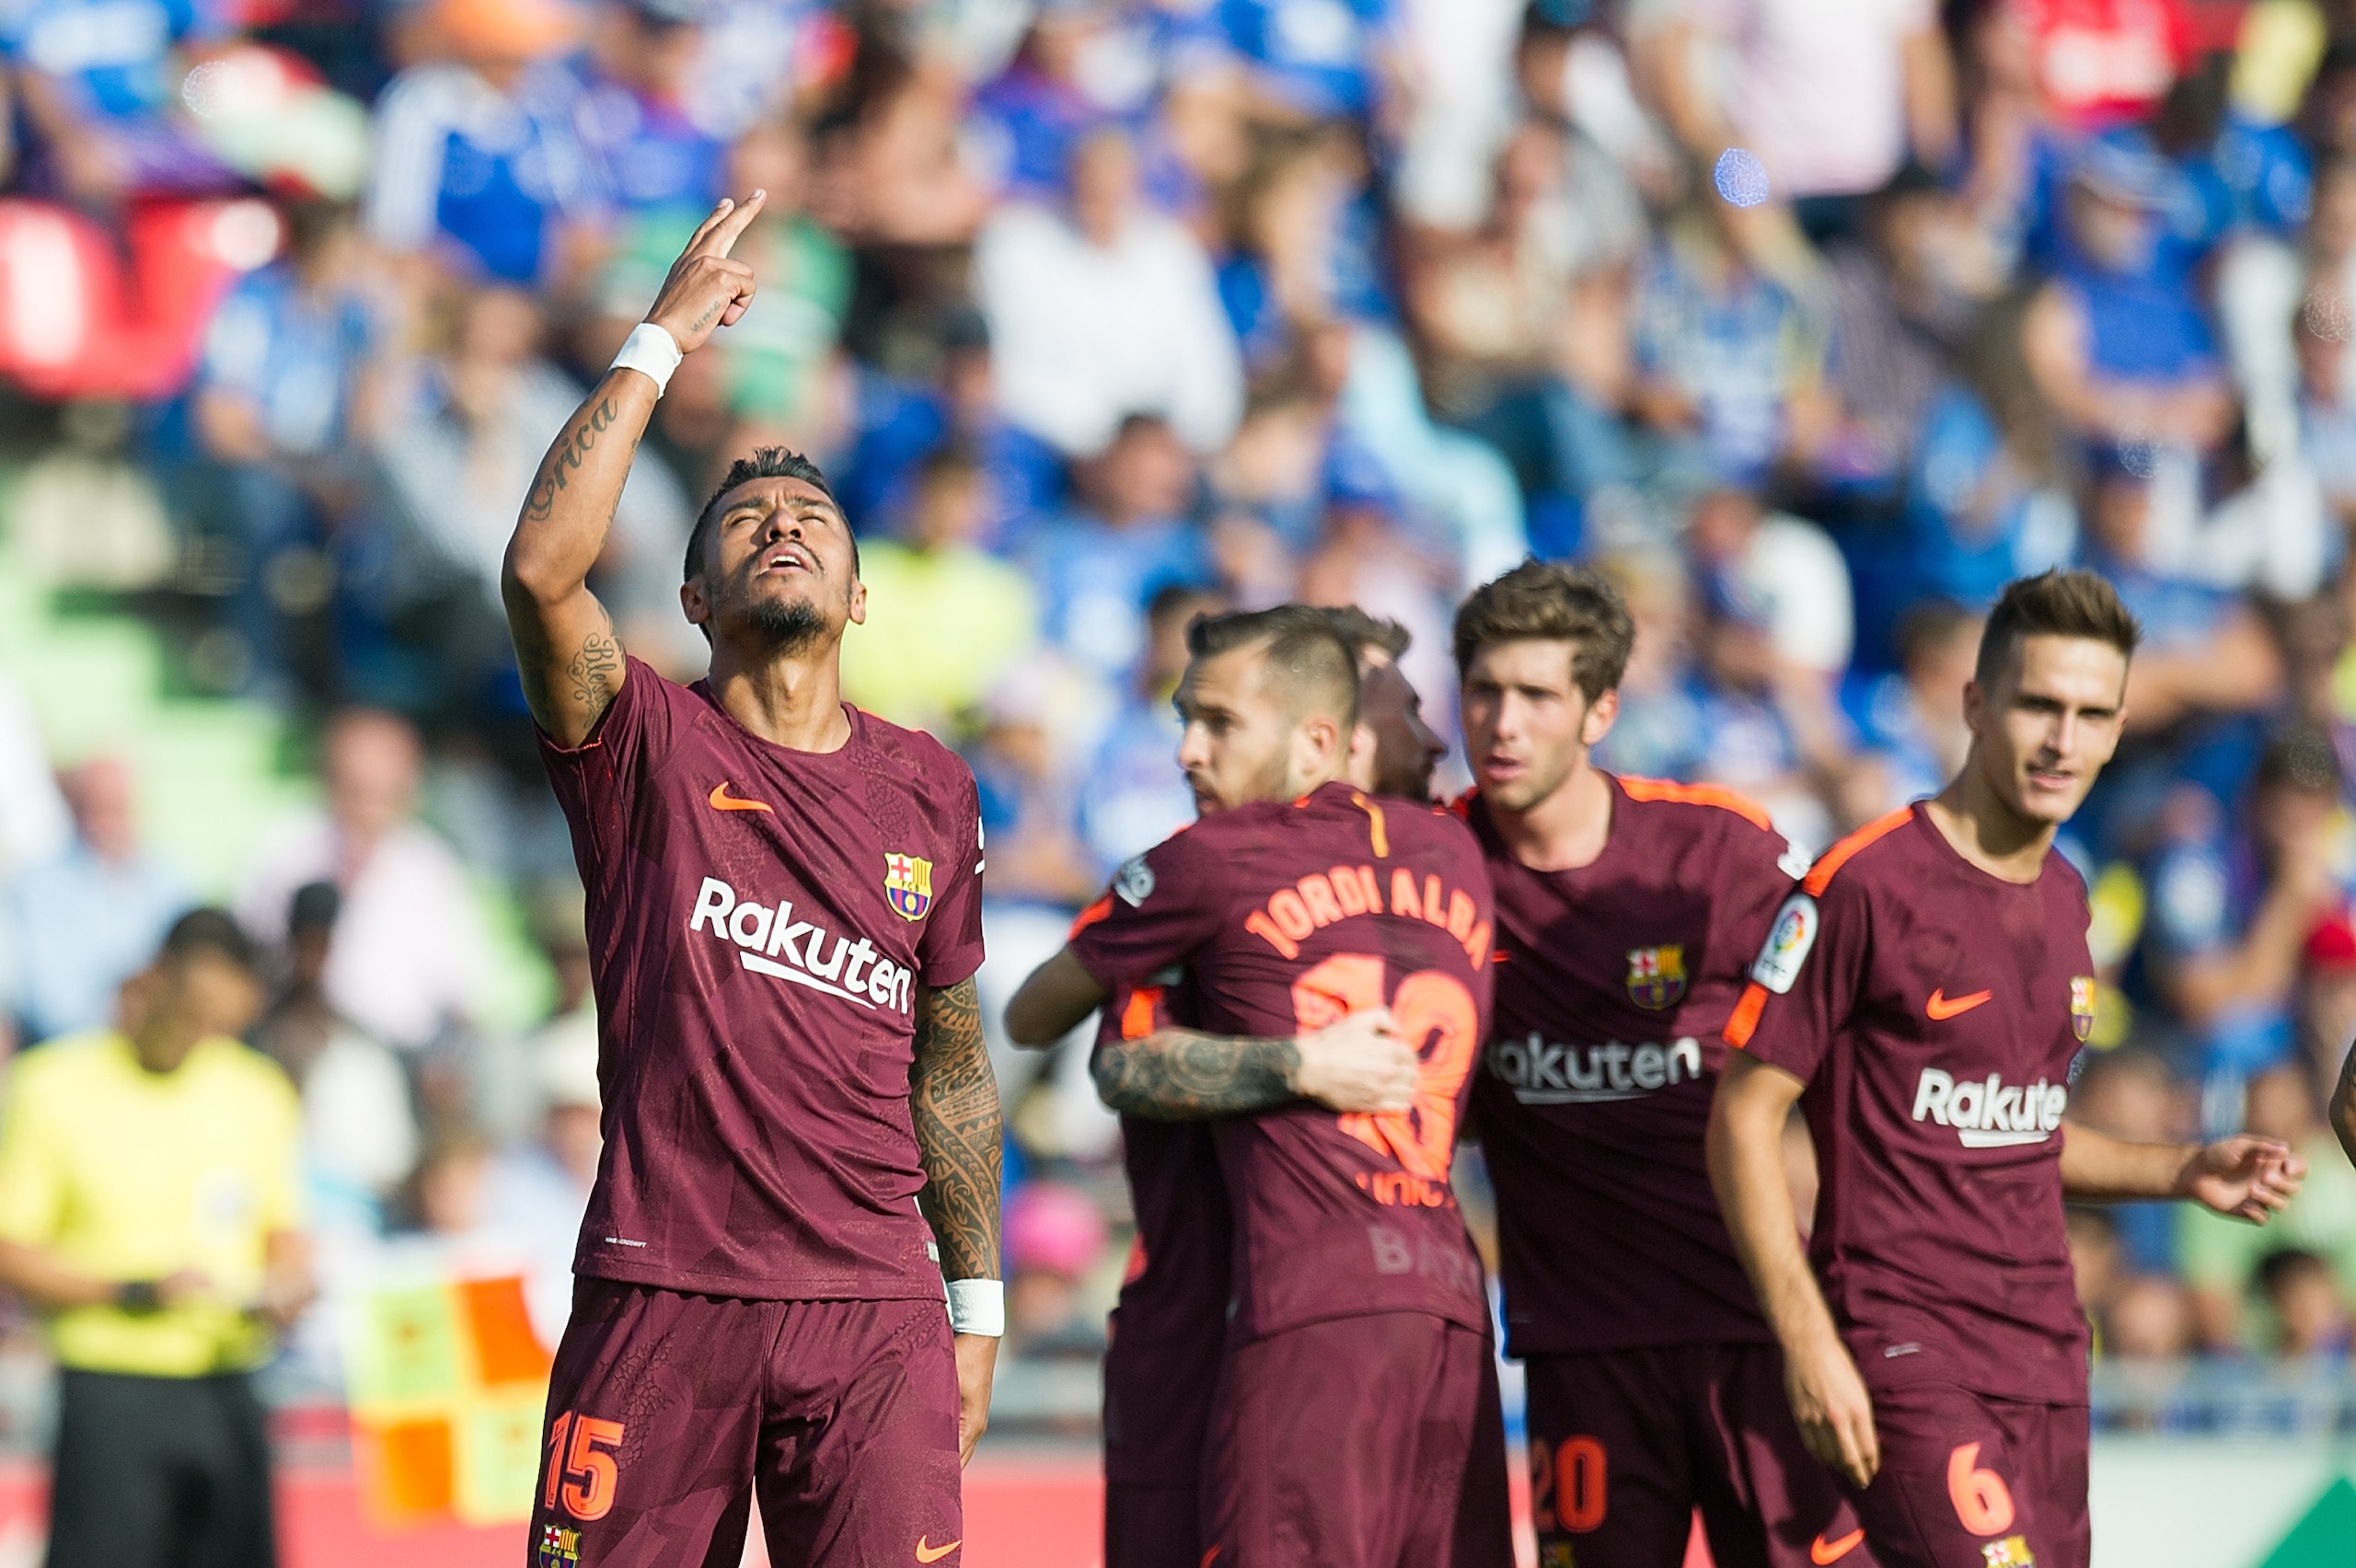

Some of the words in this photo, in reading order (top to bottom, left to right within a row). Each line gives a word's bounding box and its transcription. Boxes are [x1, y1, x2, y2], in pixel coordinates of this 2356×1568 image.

[528, 398, 618, 521] Erica
[690, 876, 911, 1014] Rakuten
[1244, 865, 1383, 960] JORDI
[1391, 868, 1491, 971] ALBA
[1912, 1067, 2067, 1132] Rakute
[545, 1410, 625, 1521] 15
[1530, 1435, 1607, 1534] 20
[1946, 1441, 2015, 1537] 6
